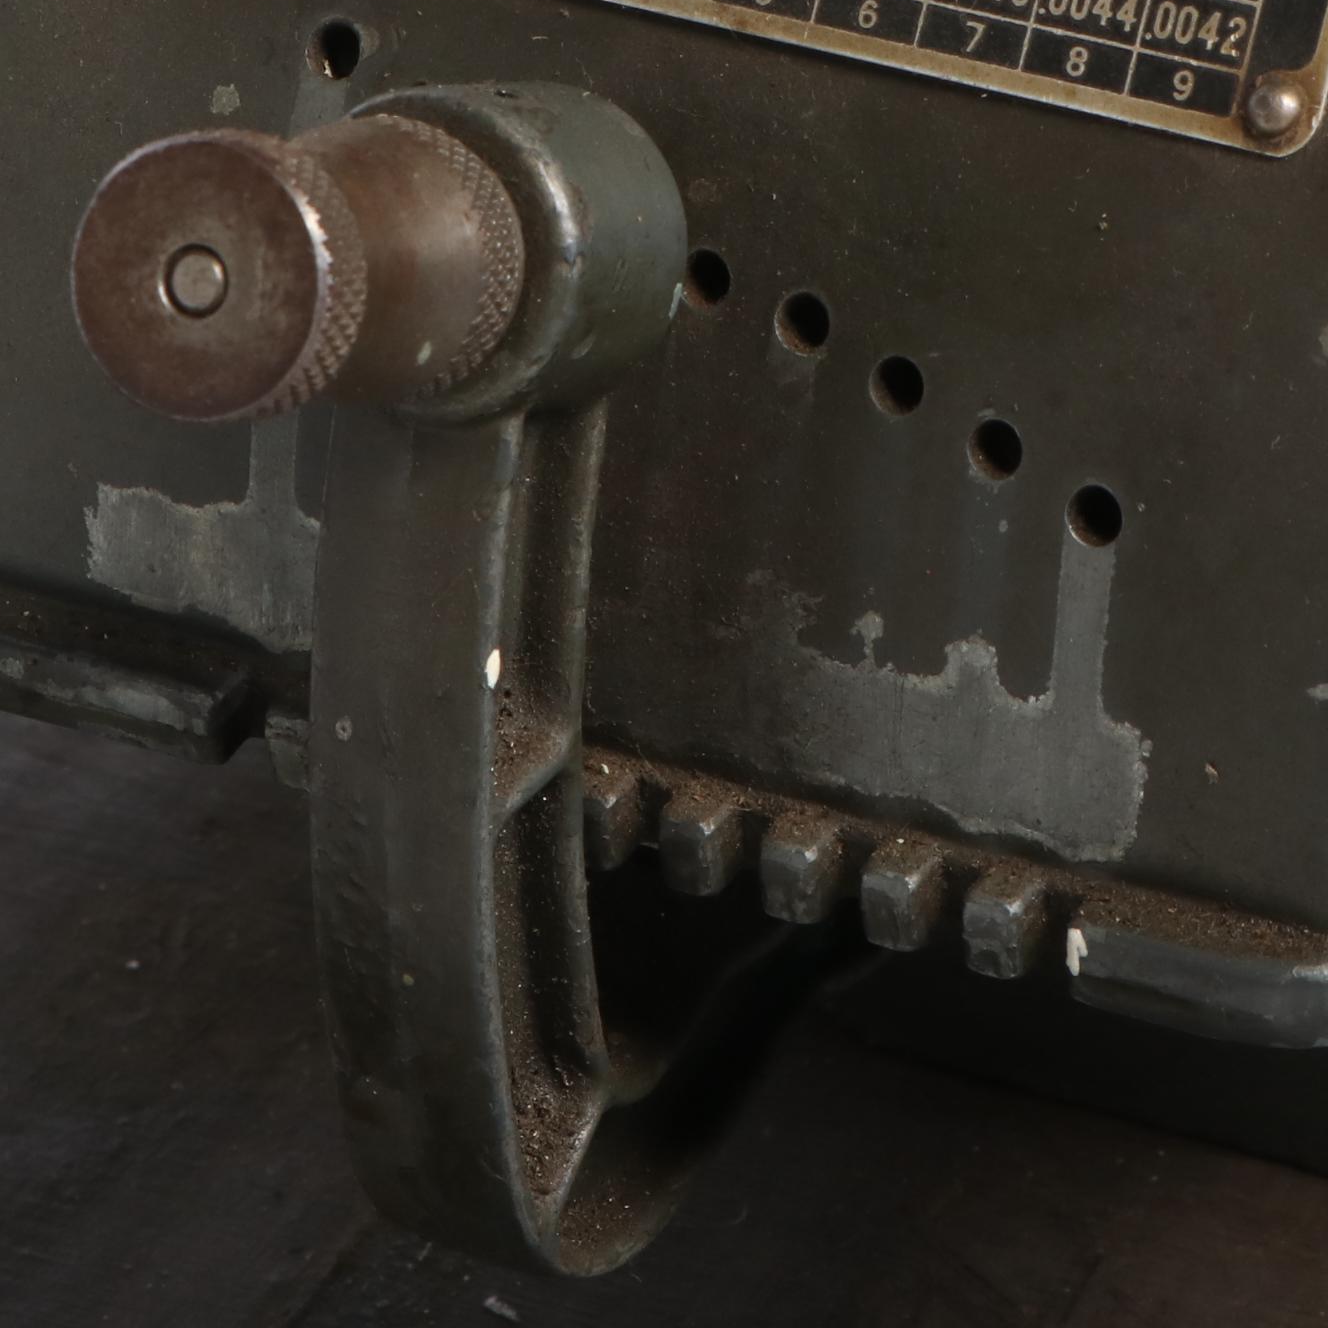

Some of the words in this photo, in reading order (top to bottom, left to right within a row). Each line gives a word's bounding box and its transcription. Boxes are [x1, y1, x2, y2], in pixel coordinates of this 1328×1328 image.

[858, 0, 879, 29] 6
[966, 23, 988, 52] 7
[1066, 46, 1087, 75] 8
[1172, 72, 1194, 100] 9
[1145, 1, 1247, 57] .0042
